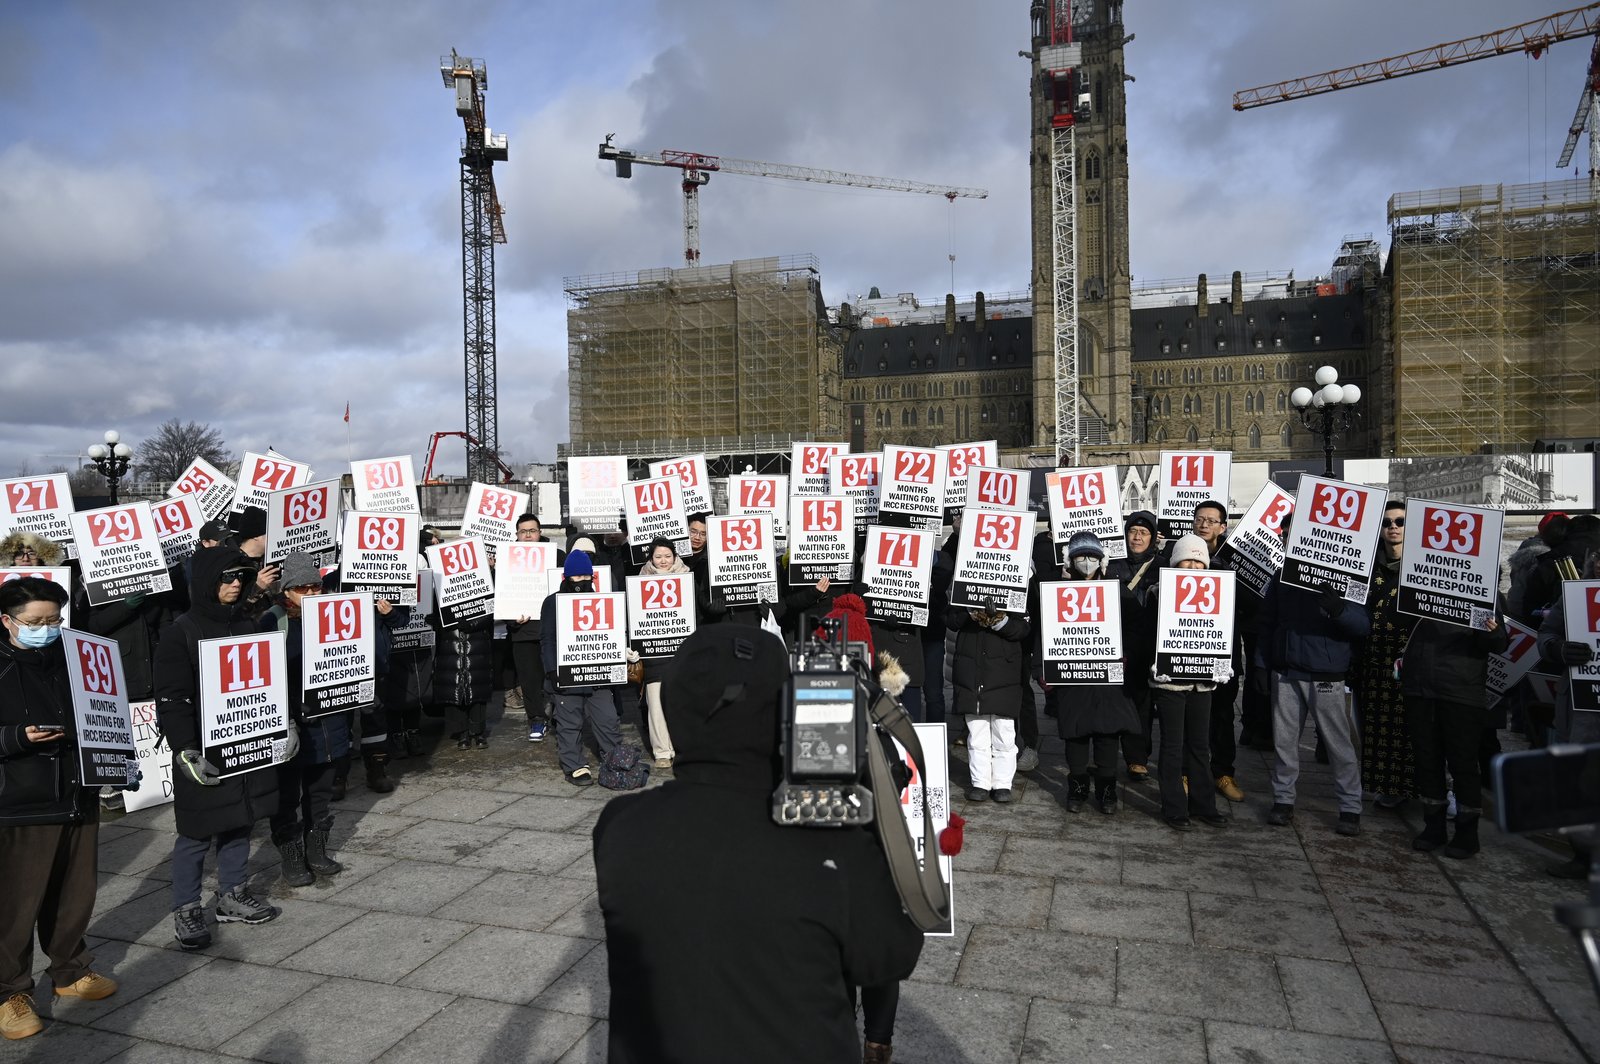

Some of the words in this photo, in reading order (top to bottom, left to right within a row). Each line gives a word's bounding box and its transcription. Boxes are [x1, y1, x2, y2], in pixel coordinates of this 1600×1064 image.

[257, 461, 292, 489] 27
[367, 462, 398, 489] 30
[845, 460, 874, 485] 34
[898, 452, 930, 483] 22
[1177, 457, 1206, 486] 11
[180, 469, 210, 499] 25
[897, 485, 928, 495] MONTHS
[982, 473, 1013, 505] 40
[1066, 474, 1100, 507] 46
[12, 481, 48, 513] 27
[372, 491, 401, 499] MONTHS
[640, 482, 668, 512] 40
[745, 481, 771, 506] 72
[889, 493, 919, 502] WAITING
[920, 495, 935, 504] FOR
[1176, 491, 1210, 499] MONTHS
[289, 489, 322, 525] 68
[482, 491, 512, 519] 33
[884, 501, 899, 509] IRCC
[900, 502, 939, 513] RESPONSE
[1315, 486, 1359, 529] 39
[17, 513, 55, 524] MONTHS
[153, 502, 185, 537] 19
[642, 513, 670, 524] MONTHS
[808, 501, 836, 531] 15
[1062, 519, 1095, 529] WAITING
[1097, 516, 1113, 525] FOR
[1069, 509, 1103, 519] MONTHS
[49, 520, 67, 529] FOR
[94, 510, 134, 545] 29
[286, 523, 320, 537] MONTHS
[471, 524, 498, 535] WAITING
[499, 530, 512, 538] FOR
[479, 518, 507, 529] MONTHS
[636, 523, 664, 533] WAITING
[665, 520, 679, 528] FOR
[979, 515, 1015, 549] 53
[1428, 510, 1475, 554] 33
[277, 534, 310, 548] WAITING
[312, 529, 328, 540] FOR
[363, 518, 399, 549] 68
[633, 534, 648, 542] IRCC
[726, 520, 757, 551] 53
[1311, 527, 1353, 545] MONTHS
[100, 544, 140, 557] MONTHS
[271, 548, 289, 559] IRCC
[290, 537, 331, 554] RESPONSE
[885, 533, 912, 567] 71
[1299, 536, 1339, 554] WAITING
[1341, 546, 1362, 559] FOR
[93, 555, 132, 568] WAITING
[133, 551, 152, 560] FOR
[362, 553, 398, 562] MONTHS
[444, 543, 473, 574] 30
[514, 546, 541, 572] 30
[726, 554, 758, 563] MONTHS
[975, 551, 1011, 562] MONTHS
[1291, 546, 1312, 559] IRCC
[1313, 551, 1365, 572] RESPONSE
[1425, 553, 1472, 571] MONTHS
[90, 569, 111, 579] IRCC
[111, 559, 160, 574] RESPONSE
[352, 562, 388, 570] WAITING
[390, 563, 407, 571] FOR
[719, 564, 750, 572] WAITING
[752, 562, 766, 570] FOR
[880, 568, 912, 579] MONTHS
[966, 560, 1000, 571] WAITING
[1002, 564, 1019, 573] FOR
[1413, 563, 1458, 580] WAITING
[1460, 571, 1483, 584] FOR
[367, 572, 411, 580] RESPONSE
[449, 572, 477, 585] MONTHS
[732, 571, 771, 581] RESPONSE
[871, 577, 903, 587] WAITING
[904, 580, 920, 589] FOR
[960, 570, 978, 579] IRCC
[978, 571, 1023, 584] RESPONSE
[442, 594, 457, 603] IRCC
[457, 585, 490, 599] RESPONSE
[444, 582, 471, 594] WAITING
[472, 578, 485, 587] FOR
[645, 580, 677, 609] 28
[883, 587, 923, 599] RESPONSE
[1406, 574, 1429, 586] IRCC
[1430, 578, 1488, 598] RESPONSE
[1179, 577, 1215, 614] 23
[1415, 592, 1427, 602] NO
[1429, 595, 1475, 612] TIMELINES
[1062, 587, 1100, 622] 34
[1418, 602, 1429, 612] NO
[1431, 605, 1470, 620] RESULTS
[324, 601, 355, 642] 19
[578, 599, 609, 630] 51
[646, 611, 677, 619] MONTHS
[1178, 618, 1214, 628] MONTHS
[639, 620, 669, 628] WAITING
[652, 626, 690, 635] RESPONSE
[1062, 627, 1100, 635] MONTHS
[576, 634, 608, 642] MONTHS
[1093, 637, 1110, 645] FOR
[1169, 629, 1204, 639] WAITING
[1206, 630, 1223, 639] FOR
[323, 645, 357, 658] MONTHS
[568, 644, 600, 652] WAITING
[602, 642, 617, 650] FOR
[1069, 648, 1116, 656] RESPONSE
[1163, 640, 1182, 649] IRCC
[1183, 640, 1227, 650] RESPONSE
[315, 658, 348, 671] WAITING
[350, 654, 365, 665] FOR
[563, 654, 580, 662] IRCC
[581, 652, 621, 660] RESPONSE
[82, 642, 112, 694] 39
[227, 643, 264, 691] 11
[309, 673, 327, 685] IRCC
[329, 665, 369, 681] RESPONSE
[90, 698, 117, 715] MONTHS
[227, 693, 267, 710] MONTHS
[85, 713, 112, 728] WAITING
[112, 717, 125, 729] FOR
[217, 708, 256, 725] WAITING
[259, 704, 277, 717] FOR
[211, 727, 232, 741] IRCC
[234, 716, 282, 736] RESPONSE
[83, 730, 98, 743] IRCC
[98, 730, 130, 745] RESPONSE
[222, 746, 233, 758] NO
[235, 737, 274, 755] TIMELINES
[226, 757, 236, 769] NO
[238, 748, 271, 765] RESULTS
